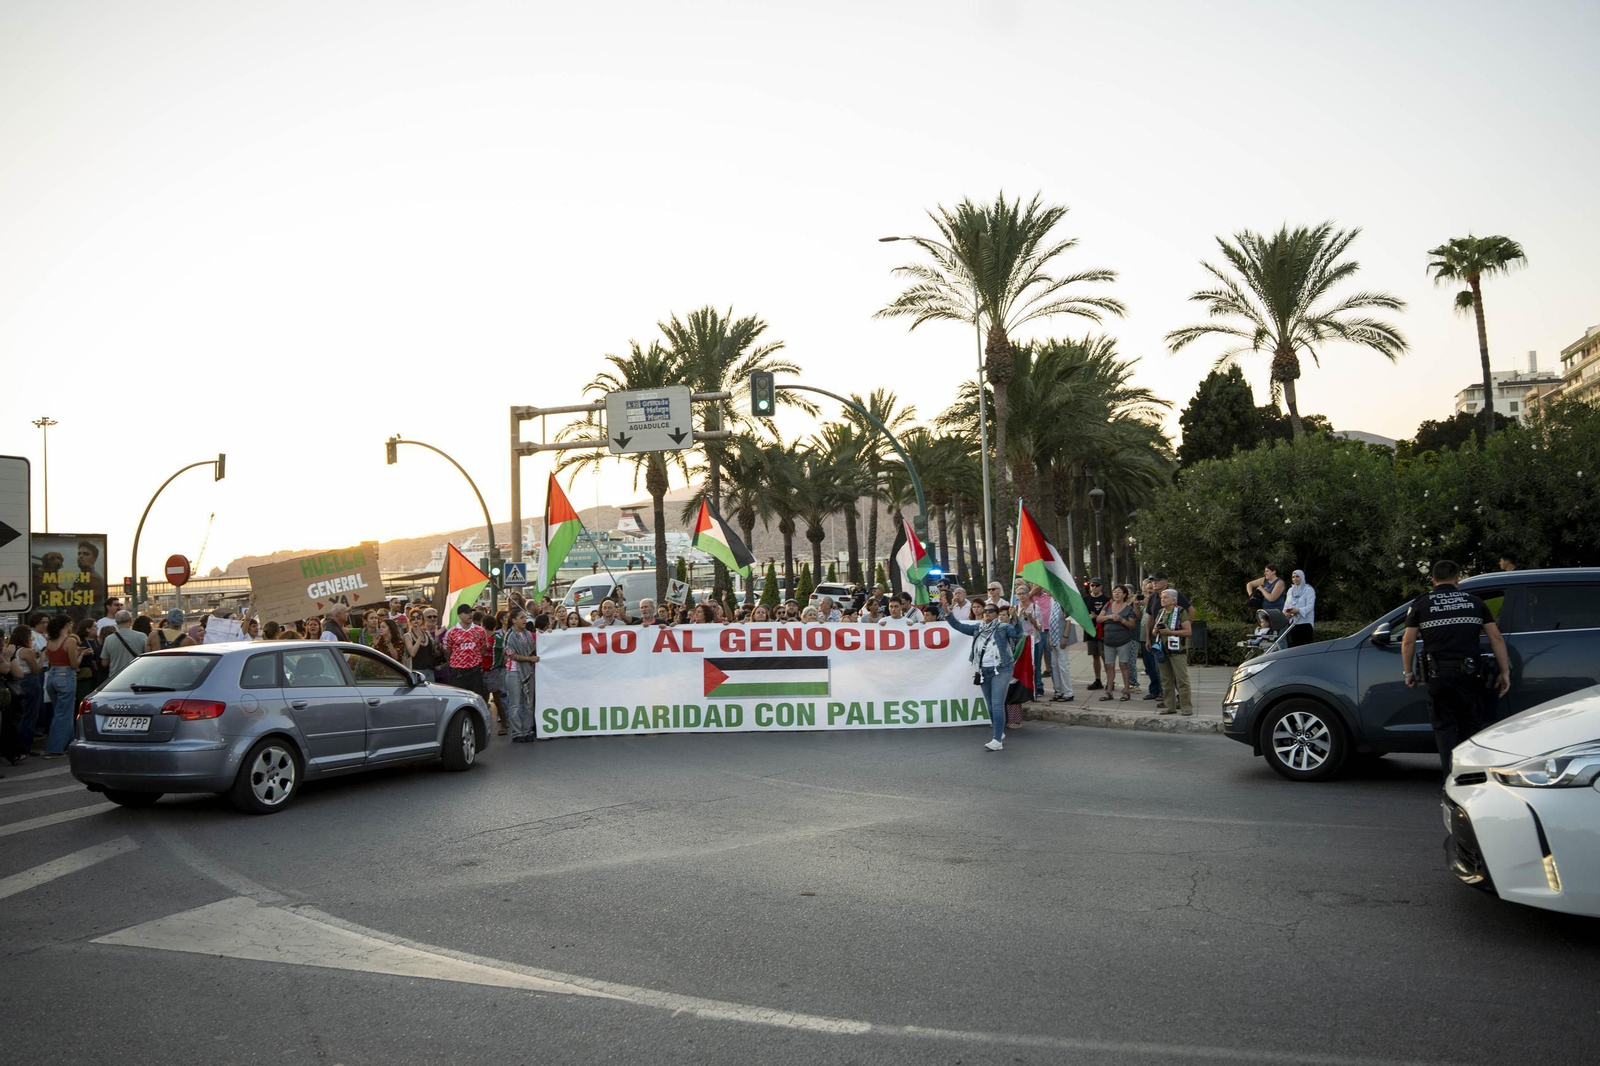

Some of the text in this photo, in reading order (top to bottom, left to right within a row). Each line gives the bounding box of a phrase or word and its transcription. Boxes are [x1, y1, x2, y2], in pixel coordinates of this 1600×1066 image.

[629, 422, 670, 431] AGUADULCE
[300, 549, 366, 579] HUELGA
[307, 572, 368, 600] GENERAL
[39, 589, 95, 607] CRUSH
[328, 595, 350, 608] YA
[581, 627, 951, 655] NO AL GENOCIDIO
[108, 716, 148, 728] 4194 FPP
[542, 697, 991, 734] SOLIDARIDAD CON PALESTINA
